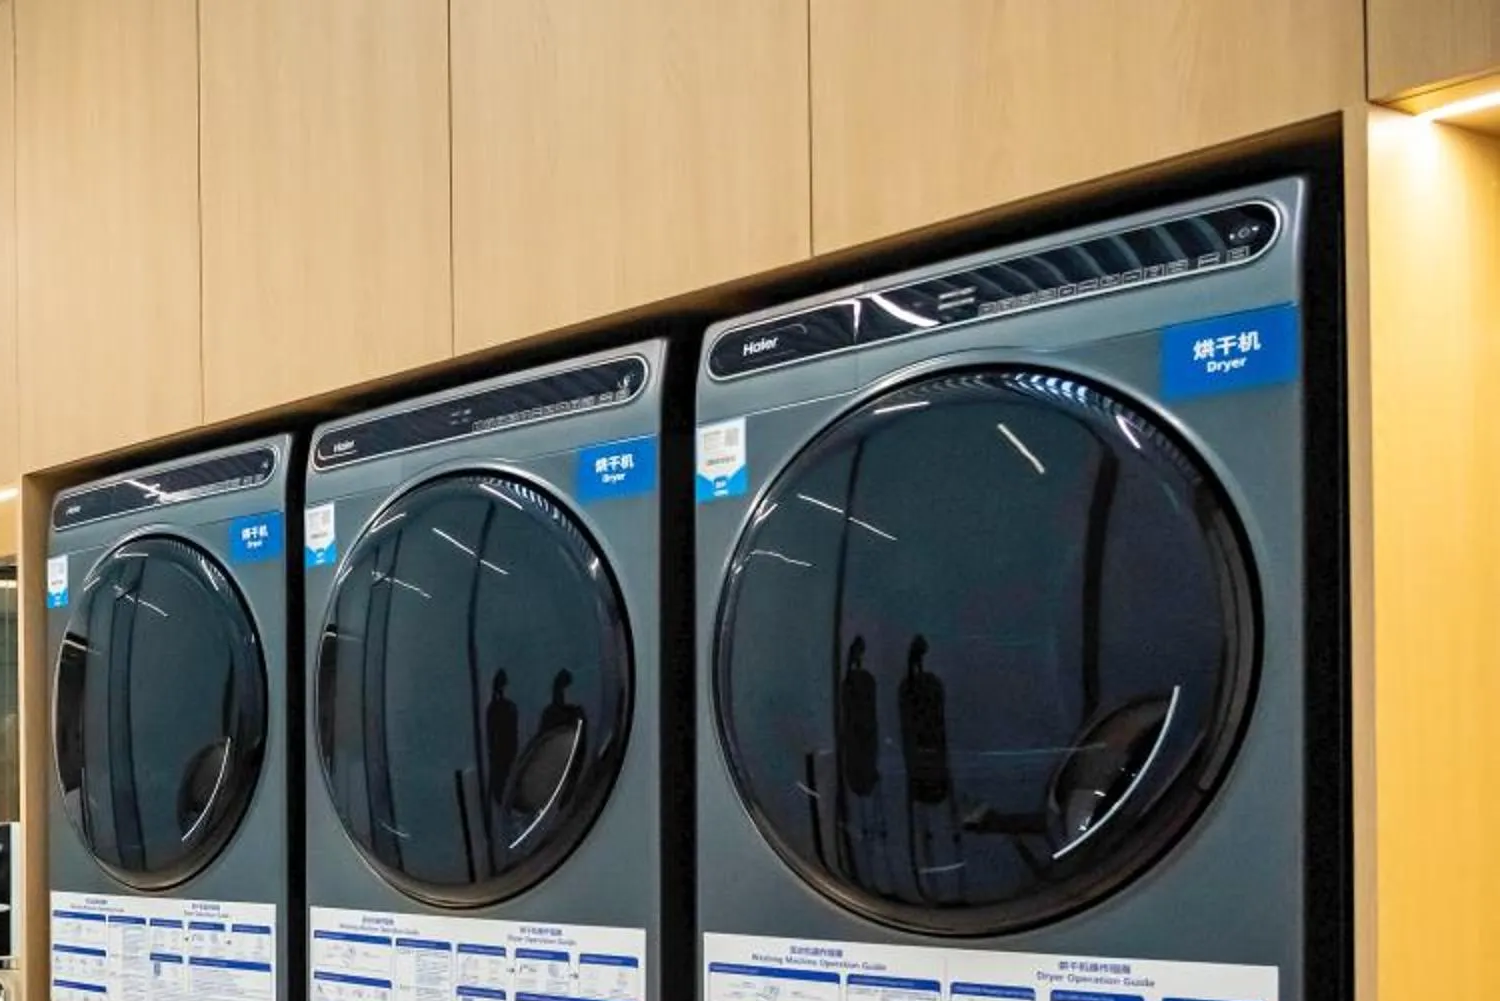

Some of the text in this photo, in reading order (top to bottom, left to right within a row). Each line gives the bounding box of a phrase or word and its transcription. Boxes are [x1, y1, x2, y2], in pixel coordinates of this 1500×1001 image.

[743, 337, 779, 357] Haier
[1193, 330, 1262, 361] 烘干机
[1207, 356, 1247, 373] Dryer
[1067, 973, 1120, 985] Operation
